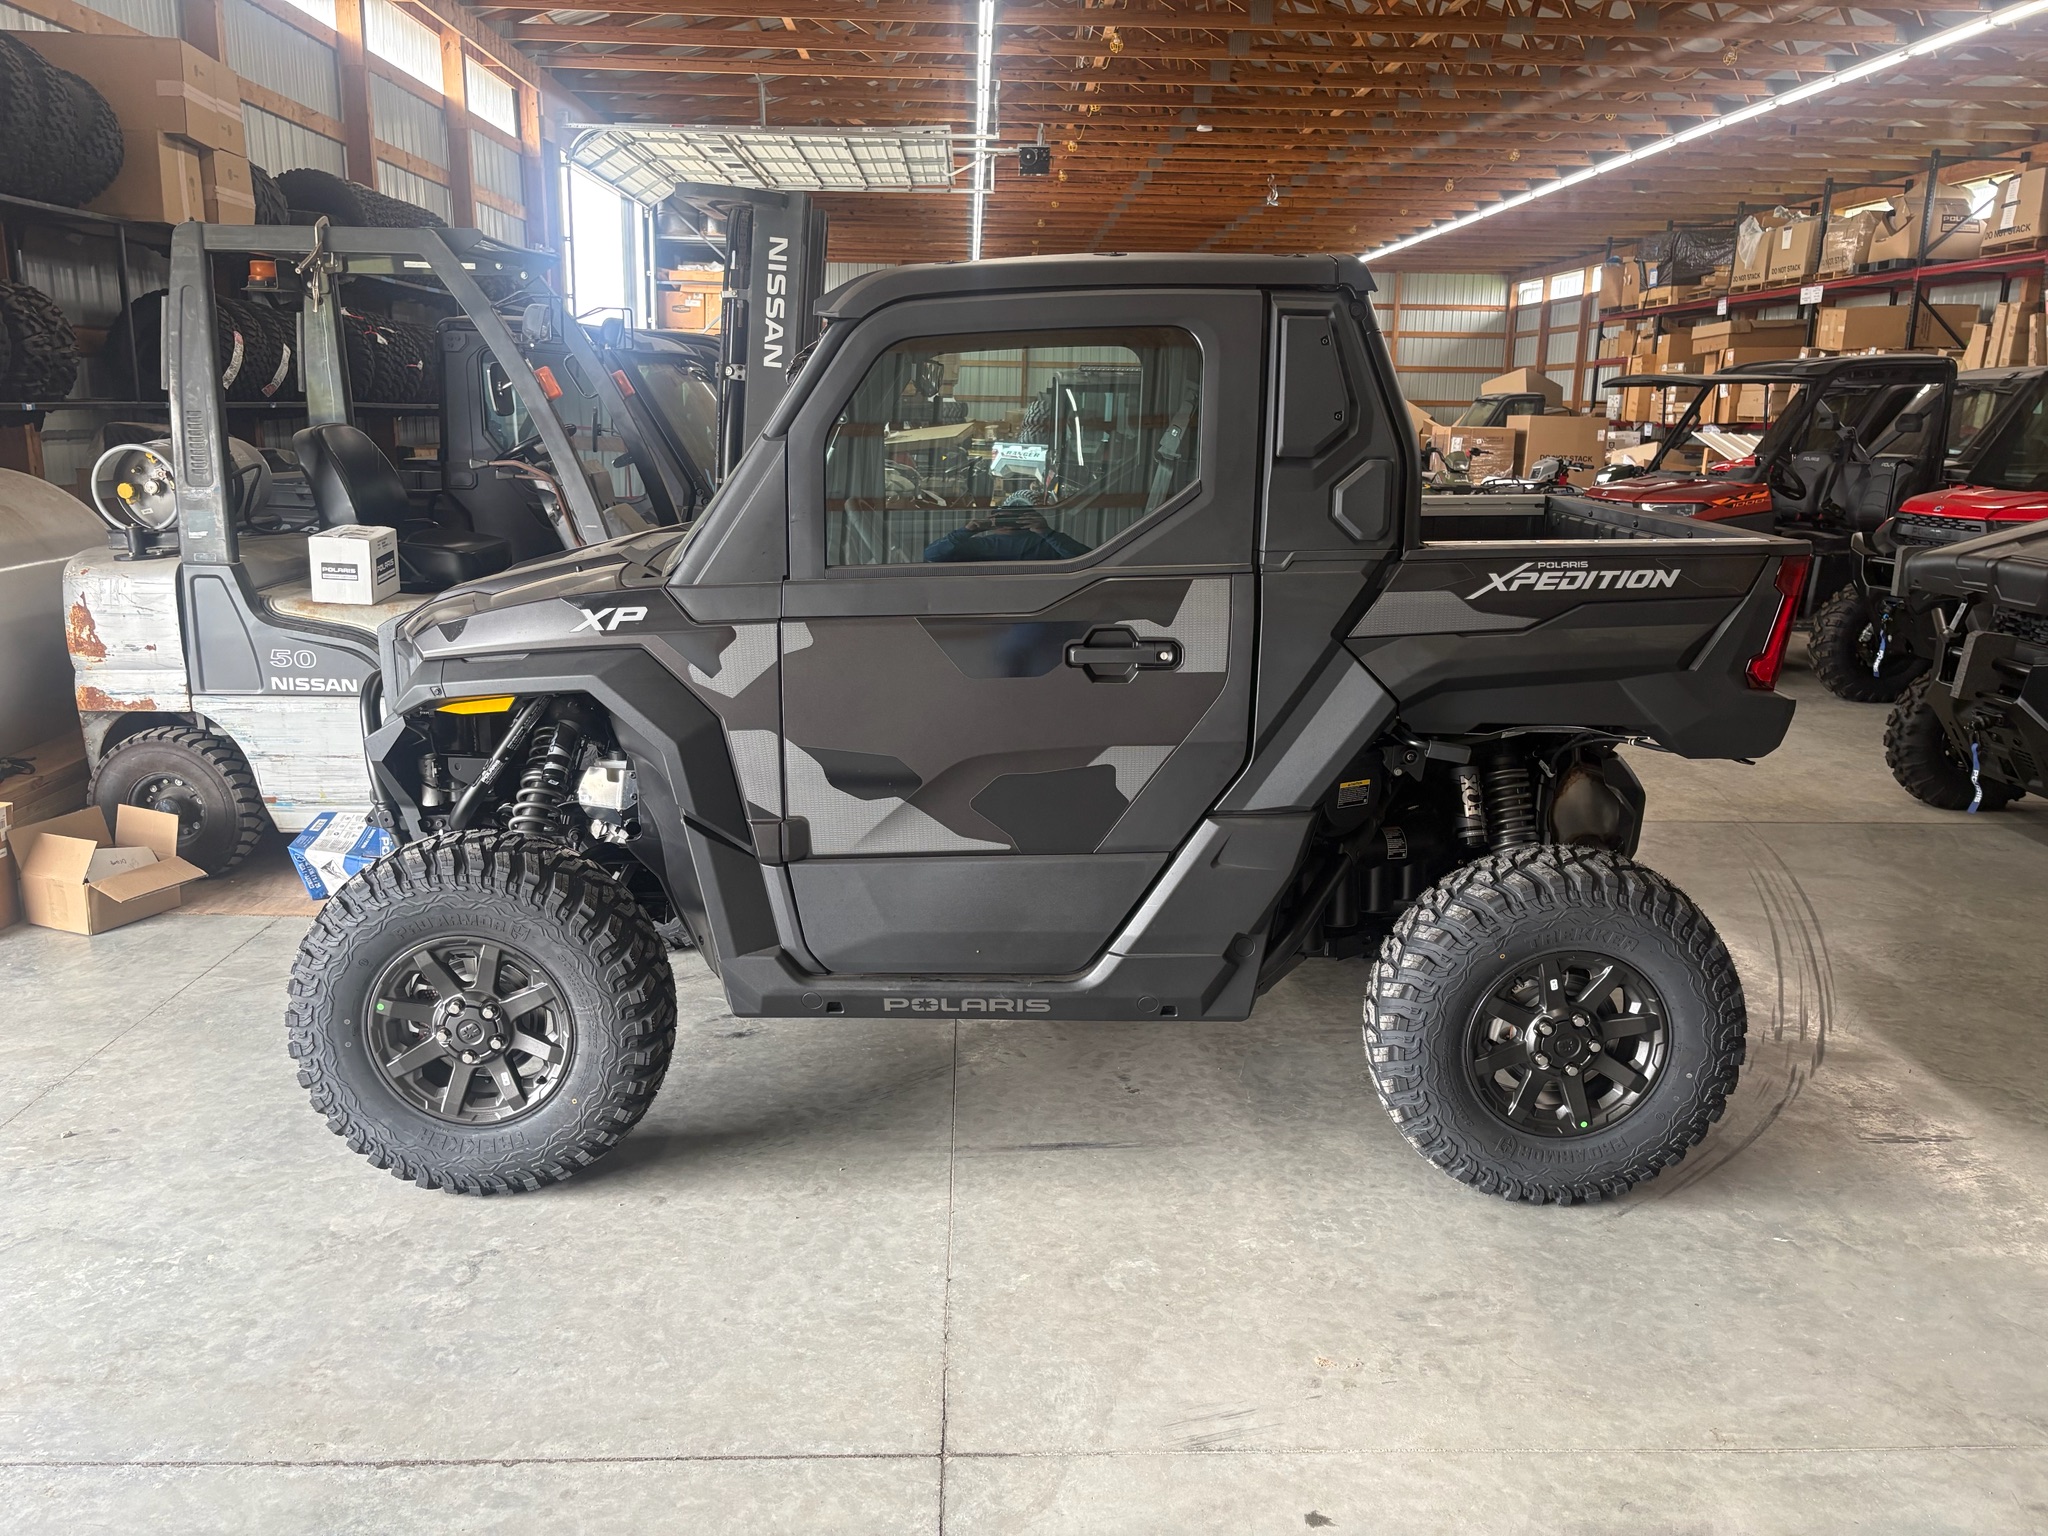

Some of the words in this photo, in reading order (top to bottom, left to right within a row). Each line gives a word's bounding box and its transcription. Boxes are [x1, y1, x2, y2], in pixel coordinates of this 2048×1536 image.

[1747, 272, 1761, 280] STACK
[1787, 264, 1801, 272] STACK
[763, 236, 789, 368] NISSAN
[322, 566, 357, 574] POLARIS
[377, 558, 394, 572] POLARIS
[1538, 560, 1588, 569] POLARIS
[1464, 562, 1681, 600] XPEDITION
[569, 606, 648, 632] XP
[269, 648, 317, 668] 50
[271, 676, 358, 692] NISSAN
[1459, 774, 1482, 818] FOX
[1524, 927, 1640, 953] TREKKER
[884, 998, 1051, 1012] POLARIS
